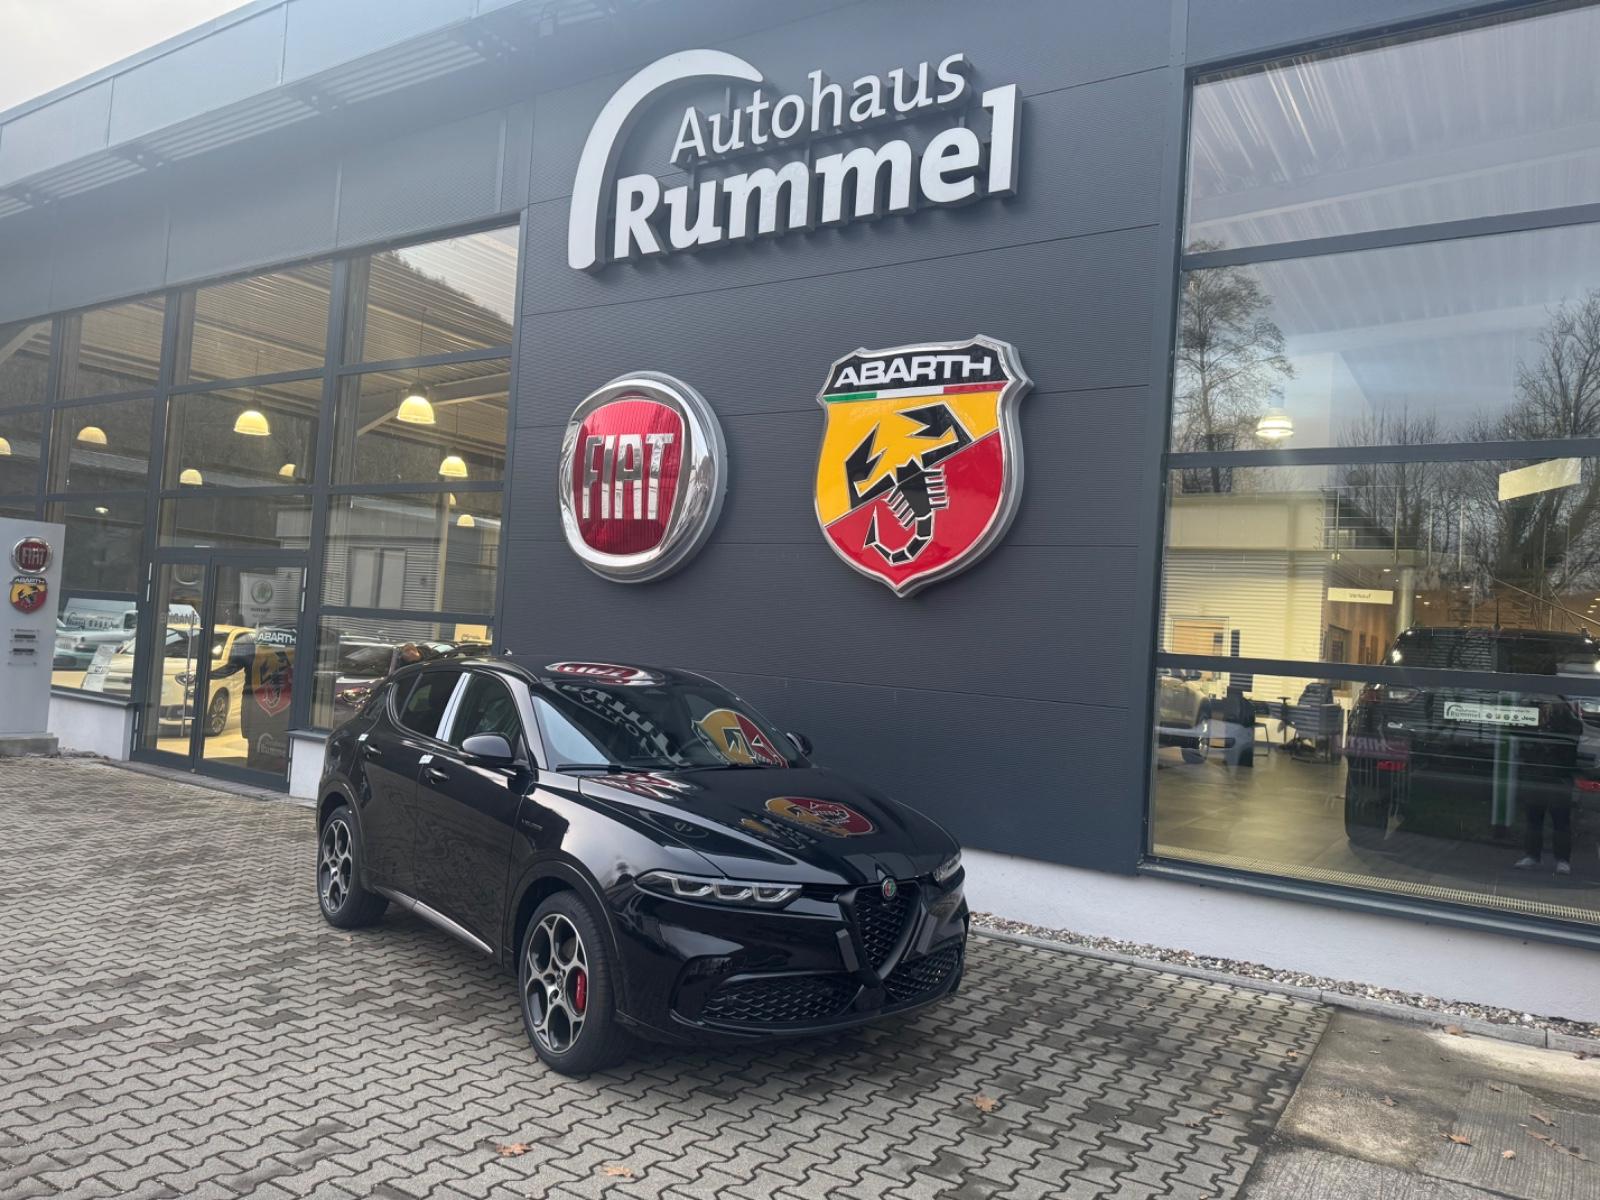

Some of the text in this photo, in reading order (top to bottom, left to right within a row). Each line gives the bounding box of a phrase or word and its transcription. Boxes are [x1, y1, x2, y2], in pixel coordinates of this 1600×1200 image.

[669, 53, 966, 164] Autohaus
[613, 84, 1017, 260] Rummel
[834, 355, 992, 388] ABARTH
[582, 432, 675, 520] FIAT
[21, 546, 46, 565] FIAT
[15, 576, 45, 584] ABARTH
[257, 632, 297, 645] ABARTH
